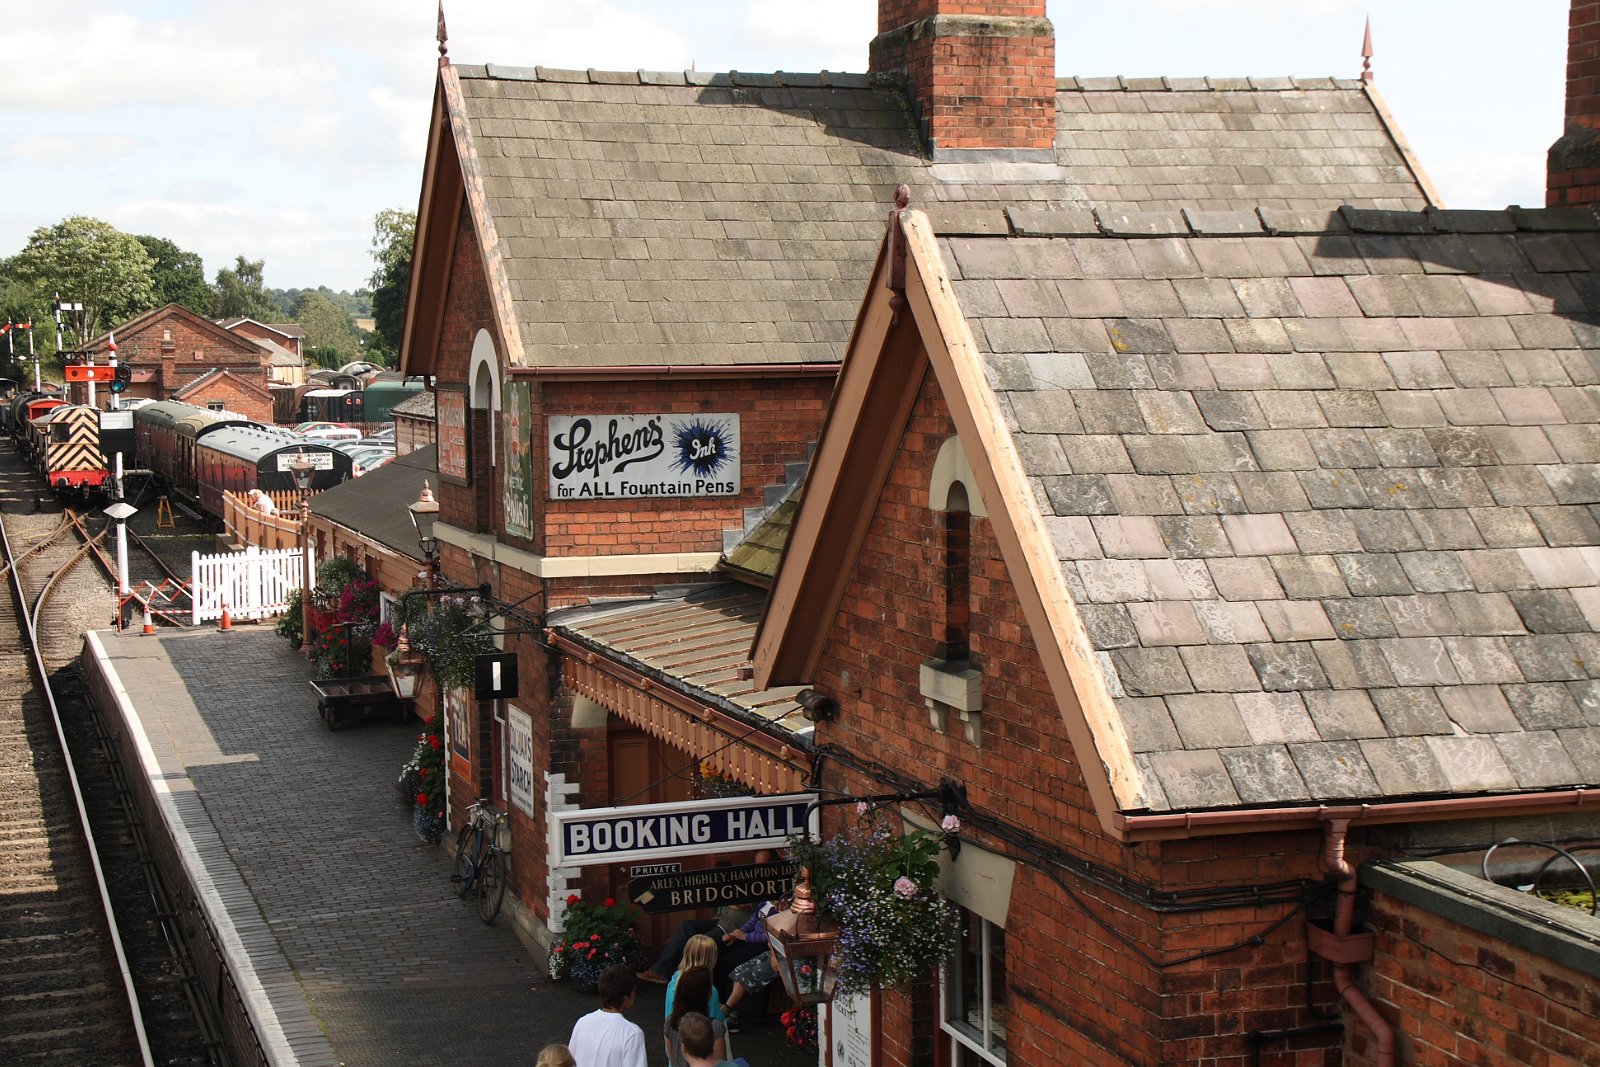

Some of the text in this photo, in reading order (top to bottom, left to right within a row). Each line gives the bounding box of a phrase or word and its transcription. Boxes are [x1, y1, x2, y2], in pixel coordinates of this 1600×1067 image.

[552, 415, 717, 479] Stephens' Ink
[557, 479, 735, 497] for ALL Fountain Pens
[511, 758, 532, 797] STARCH
[570, 806, 803, 853] BOOKING HALL
[635, 865, 677, 875] PRIVATE
[730, 866, 778, 881] HAMPTON
[781, 863, 800, 876] LOA
